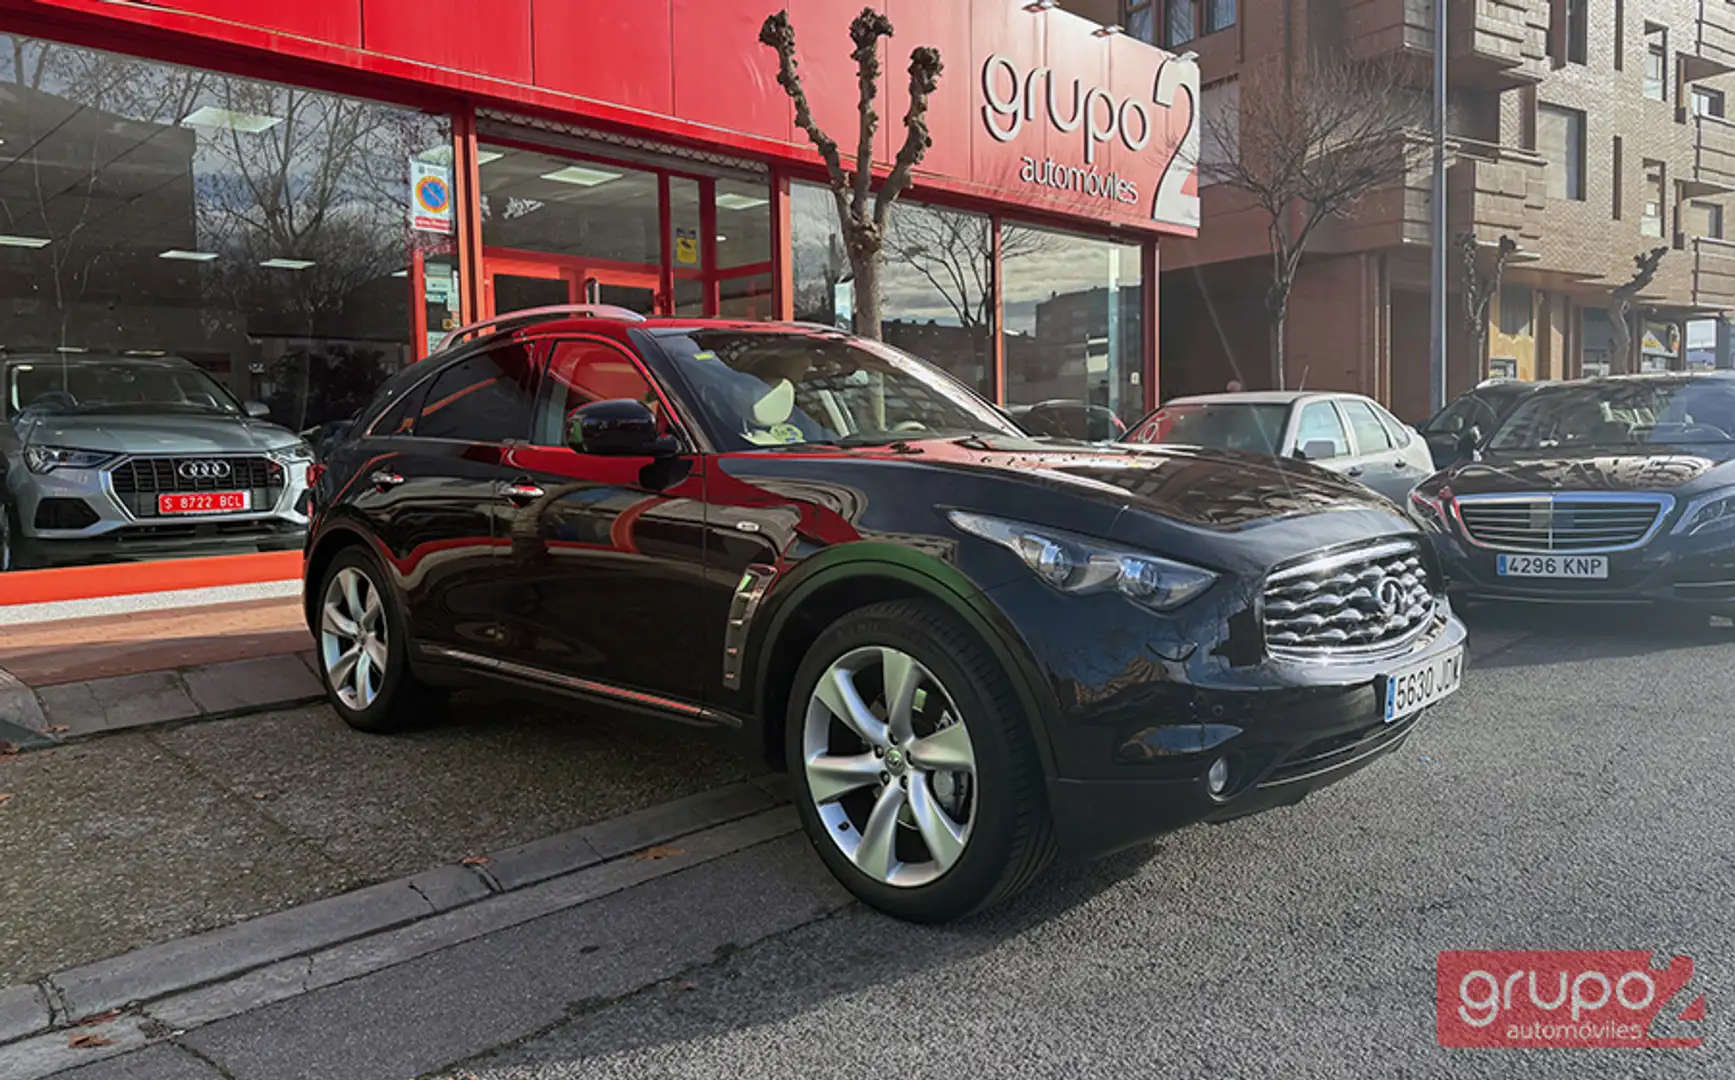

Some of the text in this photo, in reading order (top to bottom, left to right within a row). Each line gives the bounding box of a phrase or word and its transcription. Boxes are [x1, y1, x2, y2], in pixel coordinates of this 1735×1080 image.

[981, 53, 1200, 227] grupo 2
[1020, 155, 1138, 205] automóviles
[180, 496, 212, 508] 8722
[219, 495, 241, 507] BCL
[1509, 557, 1602, 575] 4296 KNP
[1396, 666, 1434, 710] 5630
